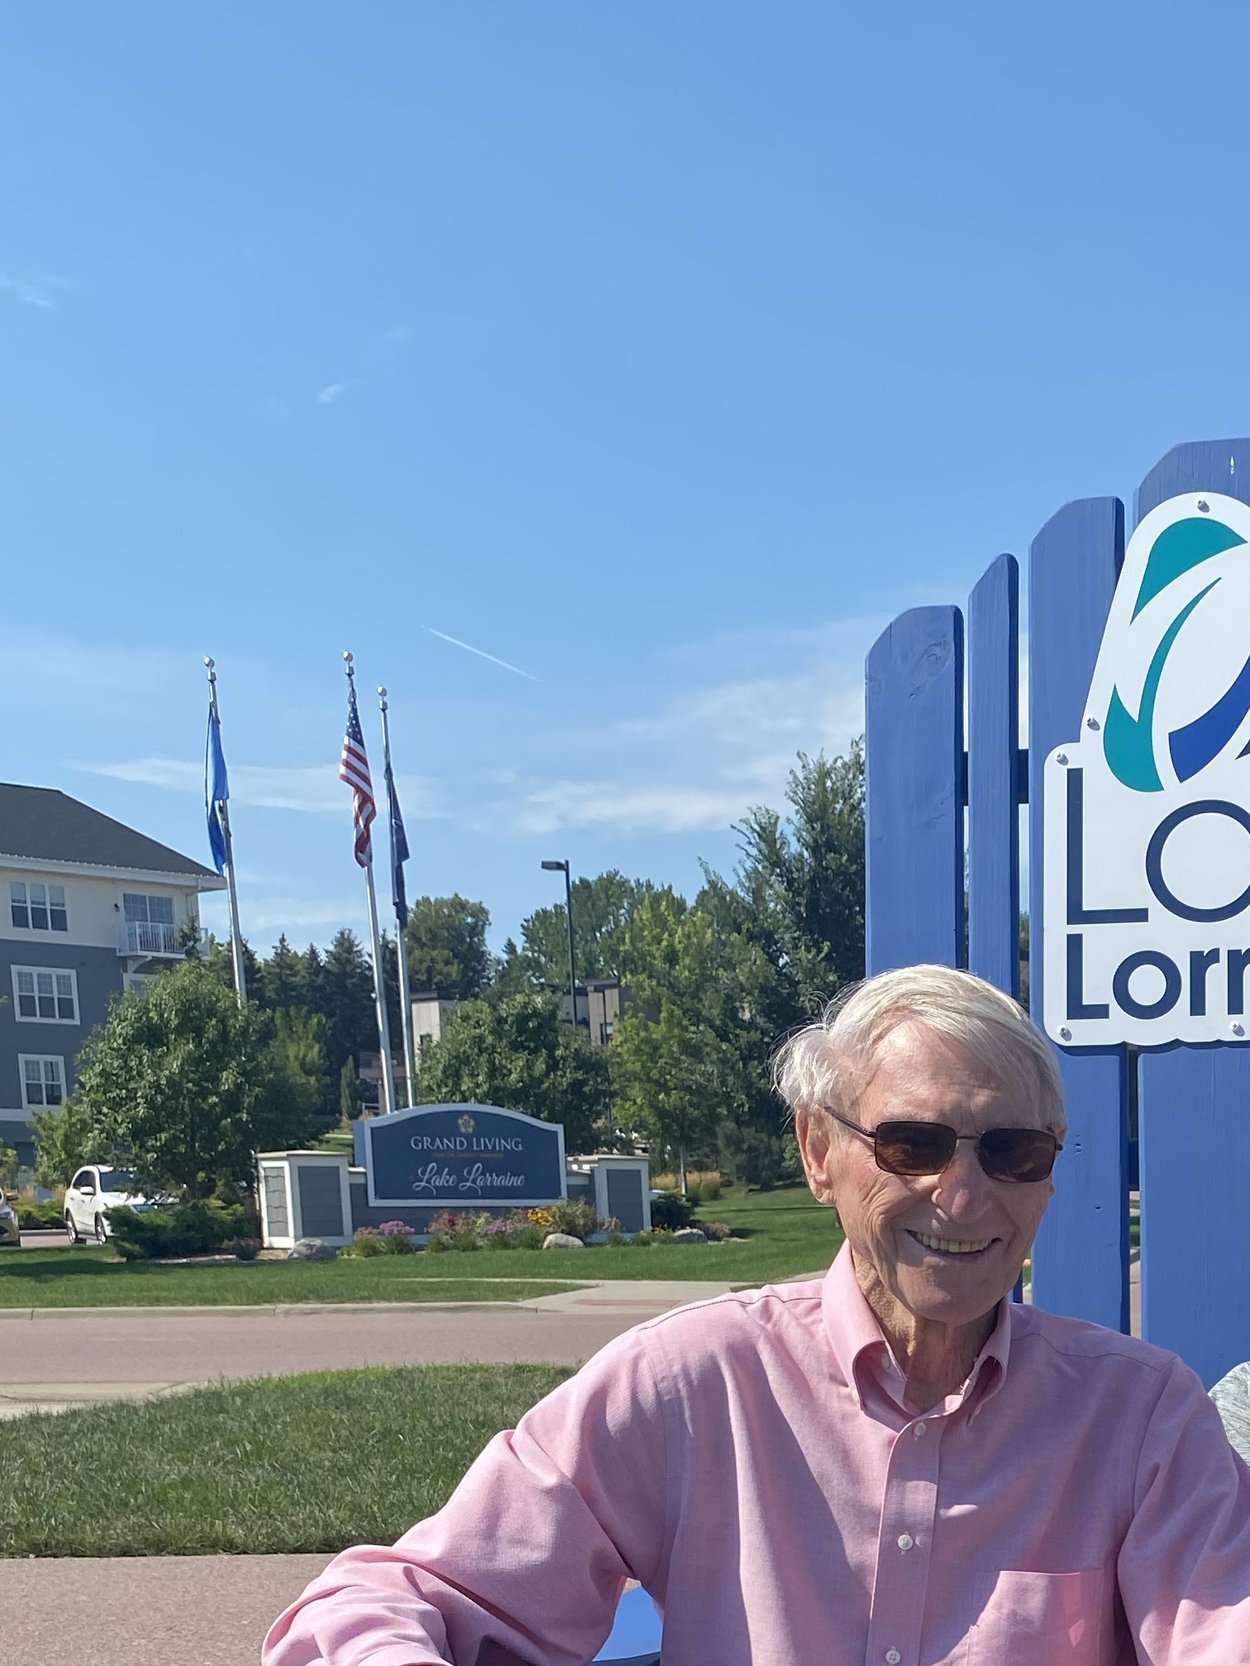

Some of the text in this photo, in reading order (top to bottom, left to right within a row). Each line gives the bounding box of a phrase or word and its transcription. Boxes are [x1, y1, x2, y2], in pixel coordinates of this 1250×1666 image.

[410, 1136, 523, 1152] GRAND LIVING
[412, 1162, 526, 1196] Lake Lorraine
